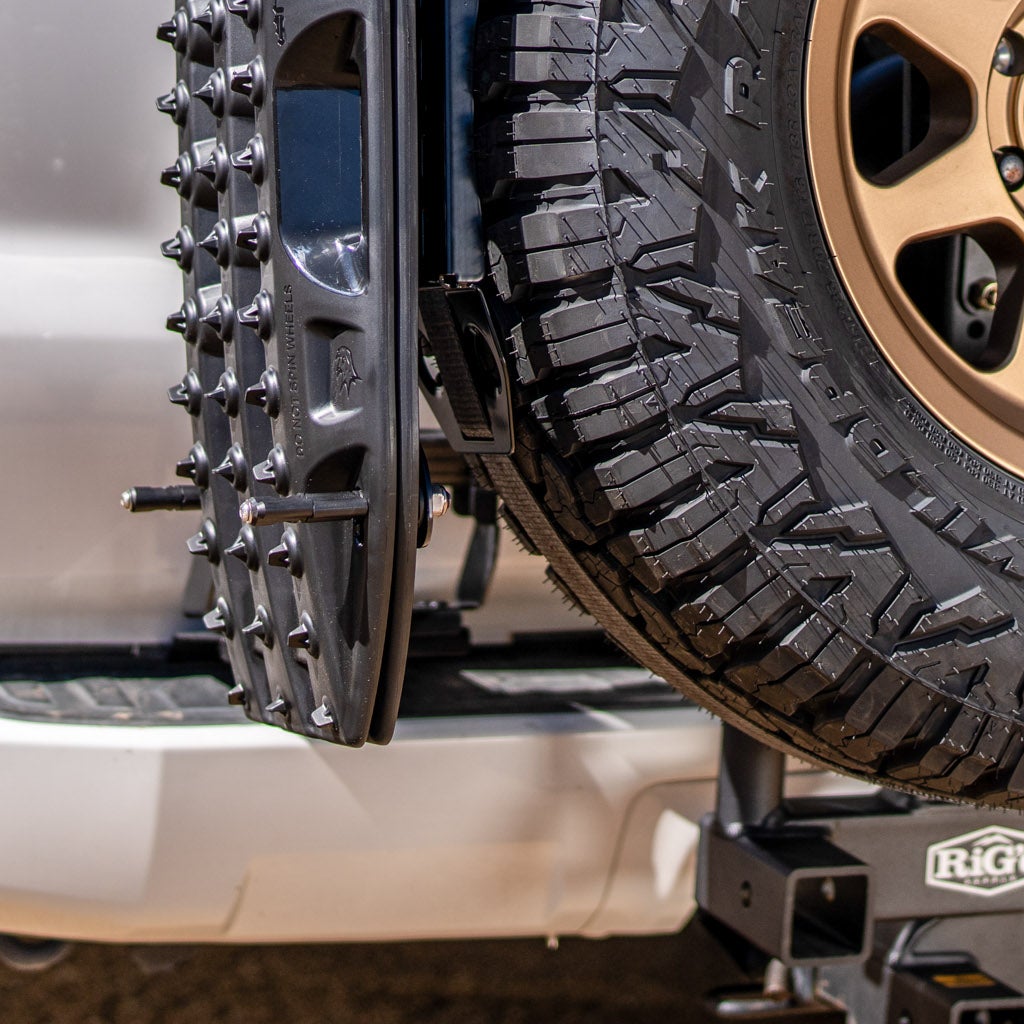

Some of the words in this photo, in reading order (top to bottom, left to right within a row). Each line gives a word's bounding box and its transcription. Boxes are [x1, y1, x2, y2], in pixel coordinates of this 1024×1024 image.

[283, 284, 297, 352] WHEELS
[287, 354, 298, 392] SPIN
[291, 397, 302, 431] NOT
[295, 433, 304, 457] DO
